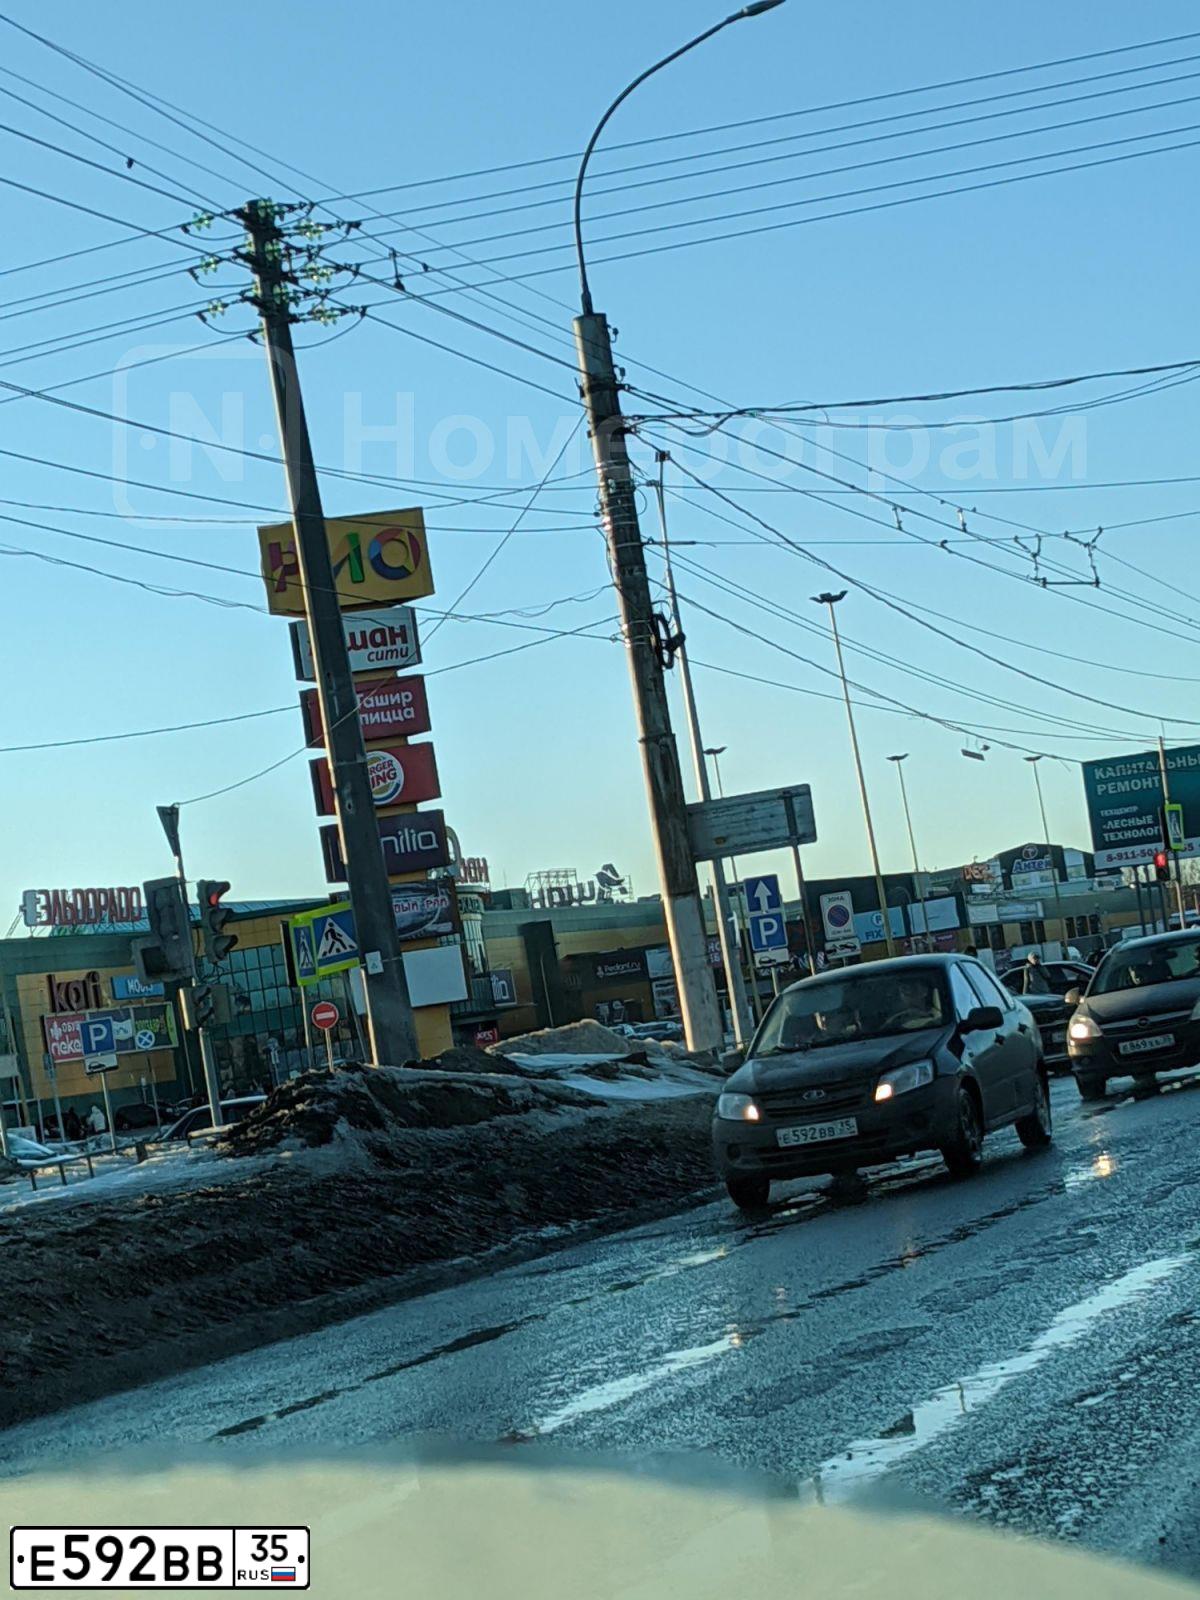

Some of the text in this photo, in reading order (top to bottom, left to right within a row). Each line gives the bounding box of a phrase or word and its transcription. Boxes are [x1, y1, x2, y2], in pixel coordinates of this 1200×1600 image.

[346, 623, 408, 652] шан
[367, 645, 409, 662] сити
[360, 707, 415, 727] пицца
[370, 760, 394, 775] RGER
[371, 768, 397, 788] ING
[1096, 775, 1160, 796] РЕМОНТ
